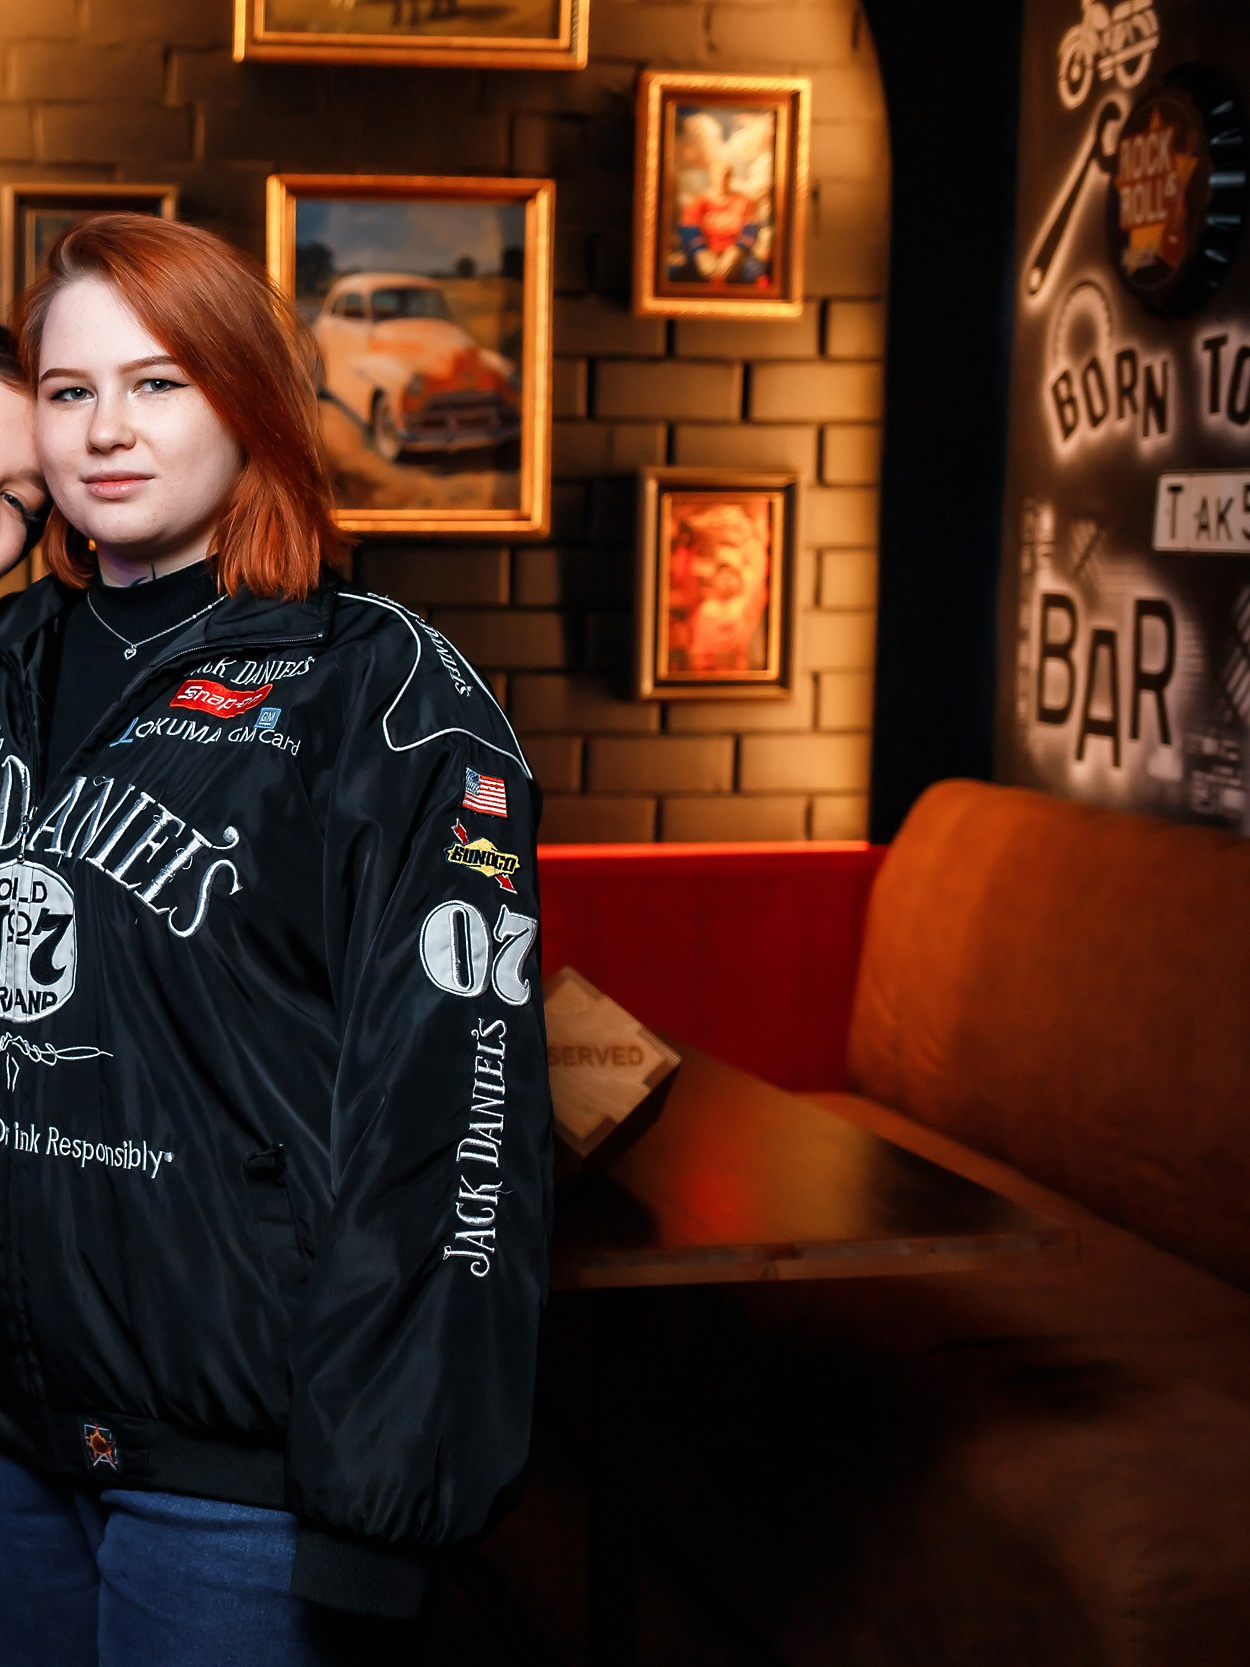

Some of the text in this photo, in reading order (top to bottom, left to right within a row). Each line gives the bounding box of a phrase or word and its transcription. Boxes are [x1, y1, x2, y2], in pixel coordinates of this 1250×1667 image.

[1120, 126, 1174, 182] ROCK
[1120, 177, 1167, 229] ROLL
[1052, 347, 1169, 440] BORN
[1036, 592, 1176, 768] BAR
[451, 846, 516, 873] SUNOCO
[419, 899, 539, 1007] 07
[548, 1046, 645, 1068] SERVED
[442, 1017, 507, 1278] JACK DANIEL'S
